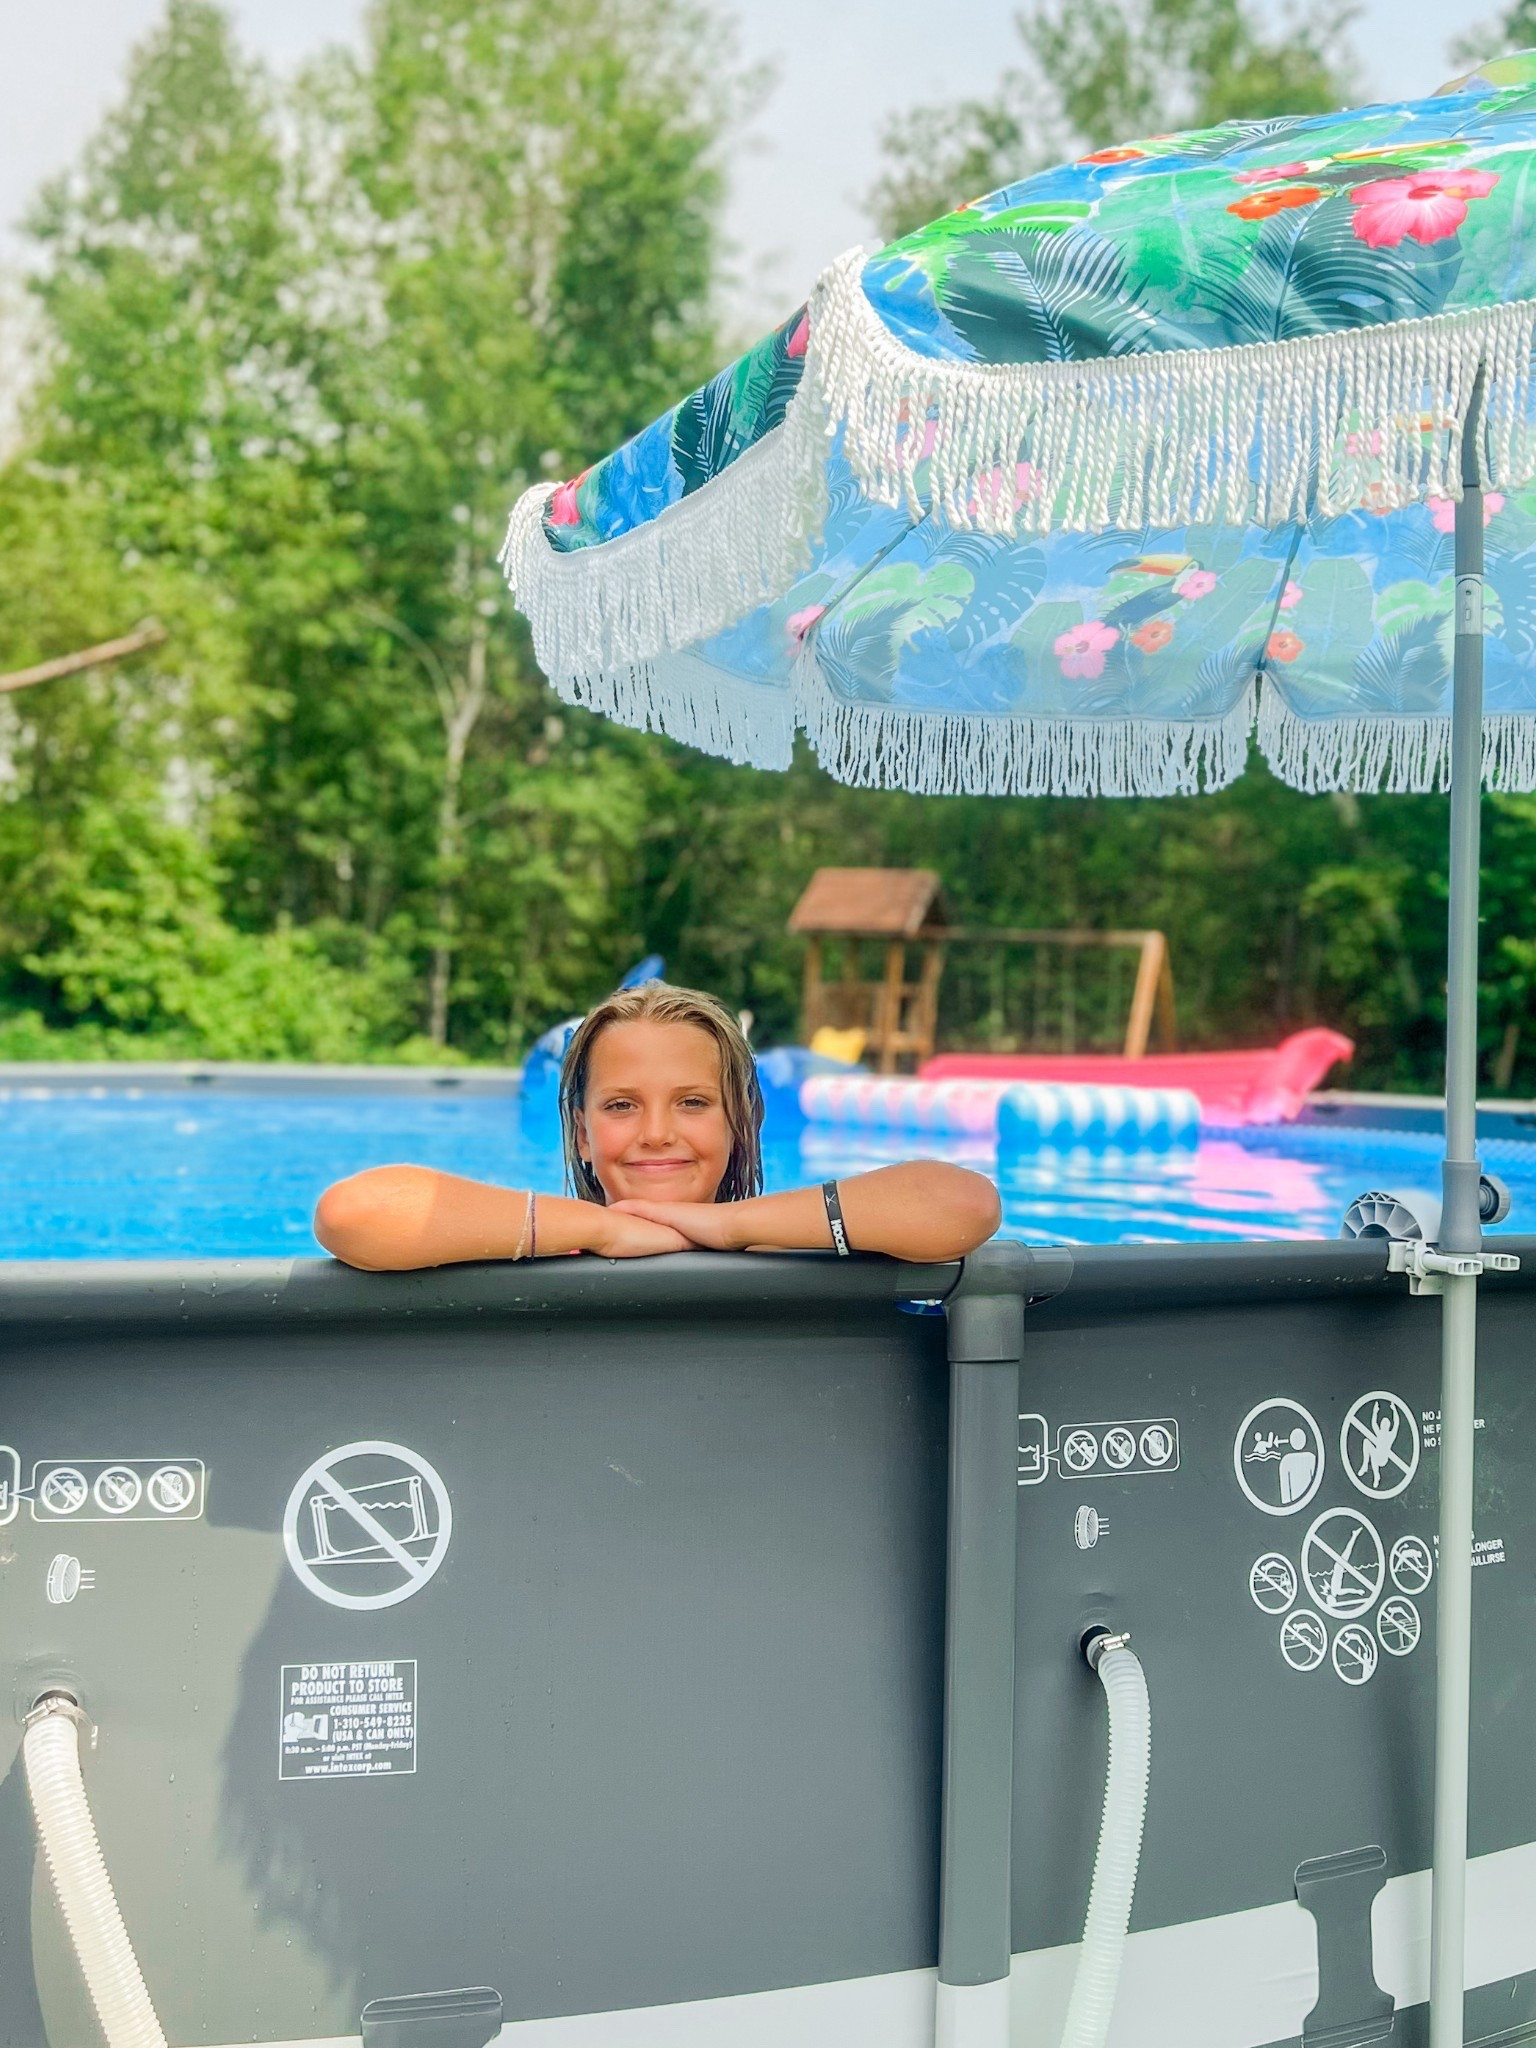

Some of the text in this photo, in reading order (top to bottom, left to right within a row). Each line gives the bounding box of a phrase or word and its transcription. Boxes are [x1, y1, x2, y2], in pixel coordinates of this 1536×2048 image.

[830, 1218, 850, 1256] HOCKE
[1422, 1410, 1435, 1421] NO
[1423, 1424, 1435, 1434] NE
[1424, 1437, 1436, 1448] NO
[1471, 1538, 1504, 1554] LONGER
[301, 1663, 395, 1681] DO NOT RETURN
[291, 1677, 404, 1697] PRODUCT TO STORE
[290, 1691, 405, 1706] FOR ASSISTANCE PLEASE CALL INTEX
[329, 1701, 413, 1717] CONSUMER SERVICE
[333, 1714, 412, 1730] 1-310-549-8235
[332, 1725, 414, 1743] (USA & CAN ONLY)
[304, 1761, 392, 1775] www.intexcorp.com
